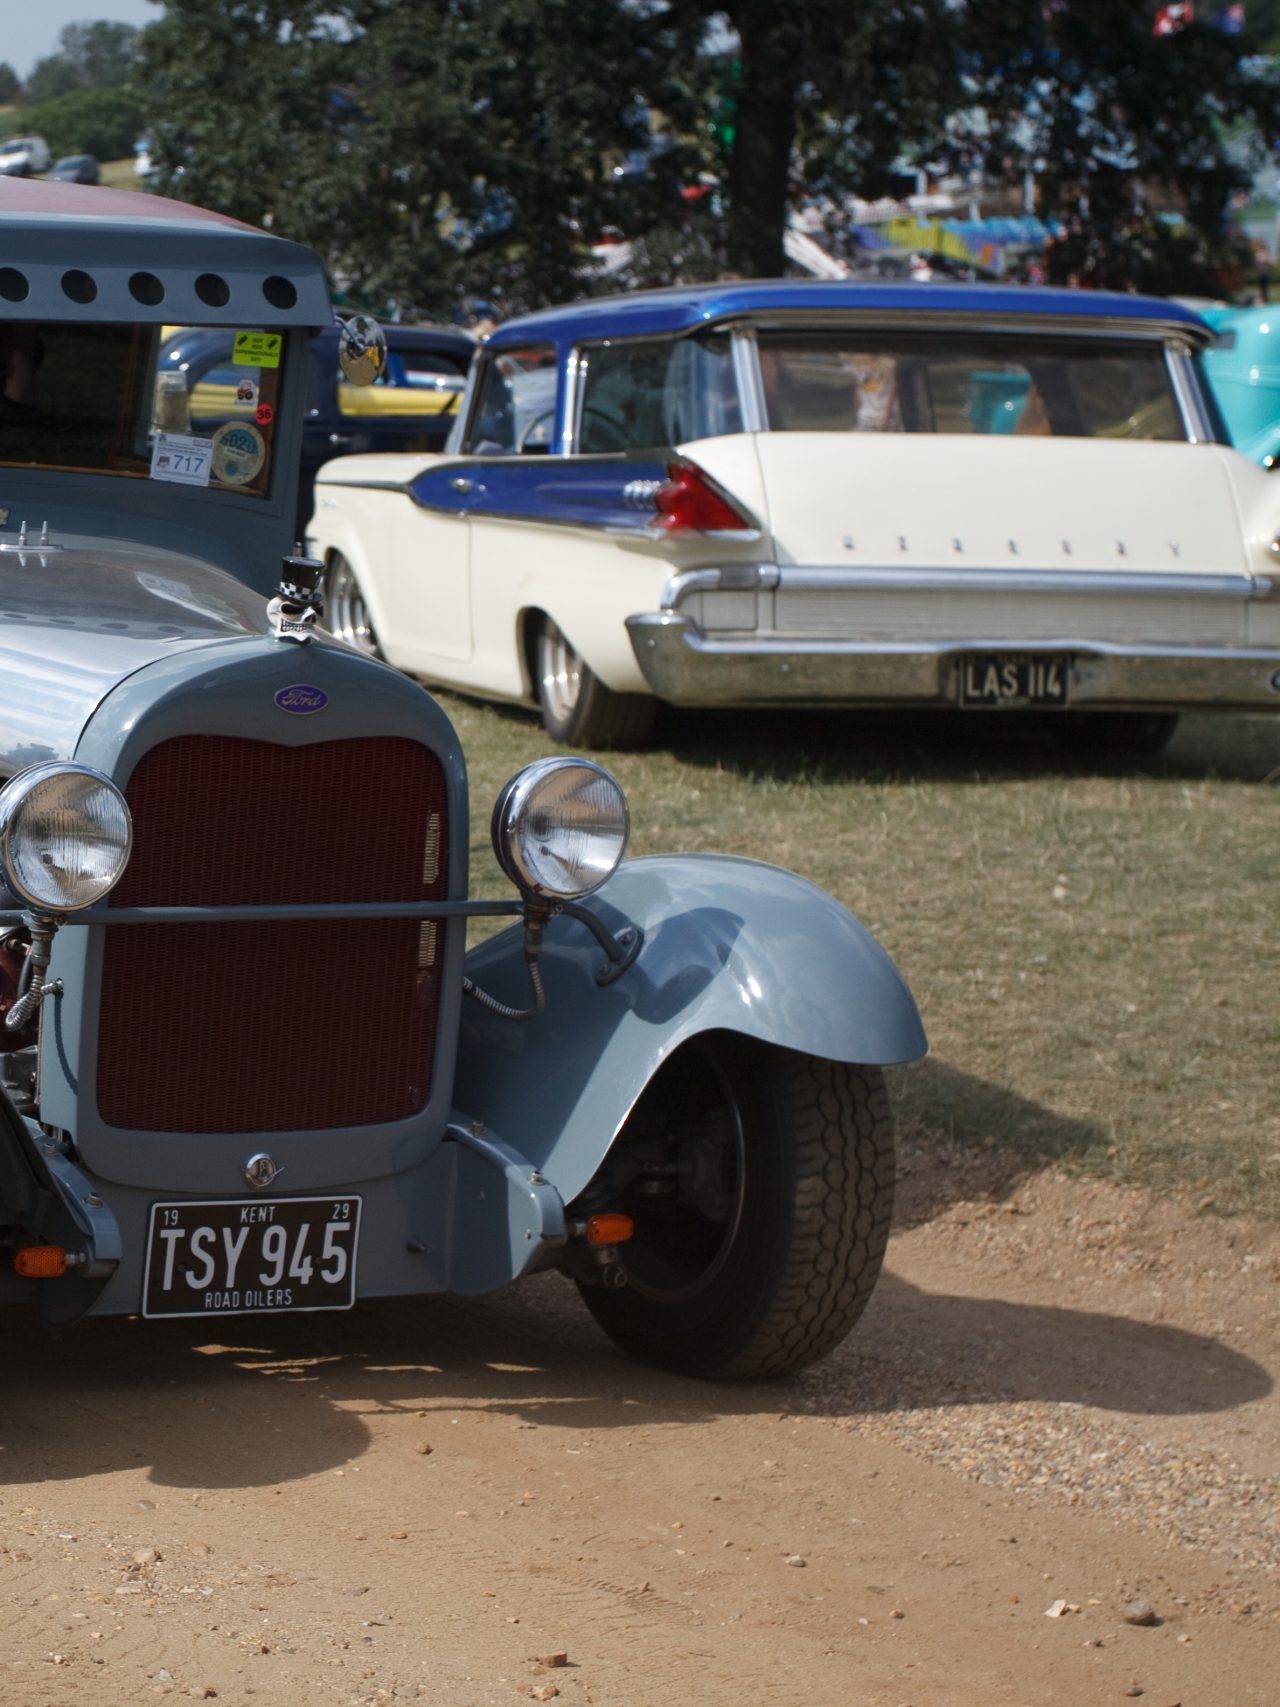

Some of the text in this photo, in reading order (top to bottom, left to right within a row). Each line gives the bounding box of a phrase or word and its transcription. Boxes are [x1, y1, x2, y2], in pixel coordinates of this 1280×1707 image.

[173, 454, 205, 473] 717
[966, 663, 1062, 698] LAS 114
[282, 688, 321, 707] Ford
[163, 1203, 350, 1226] 19 KENT 29
[159, 1221, 352, 1292] TSY 945
[205, 1288, 293, 1309] ROAD OILERS
